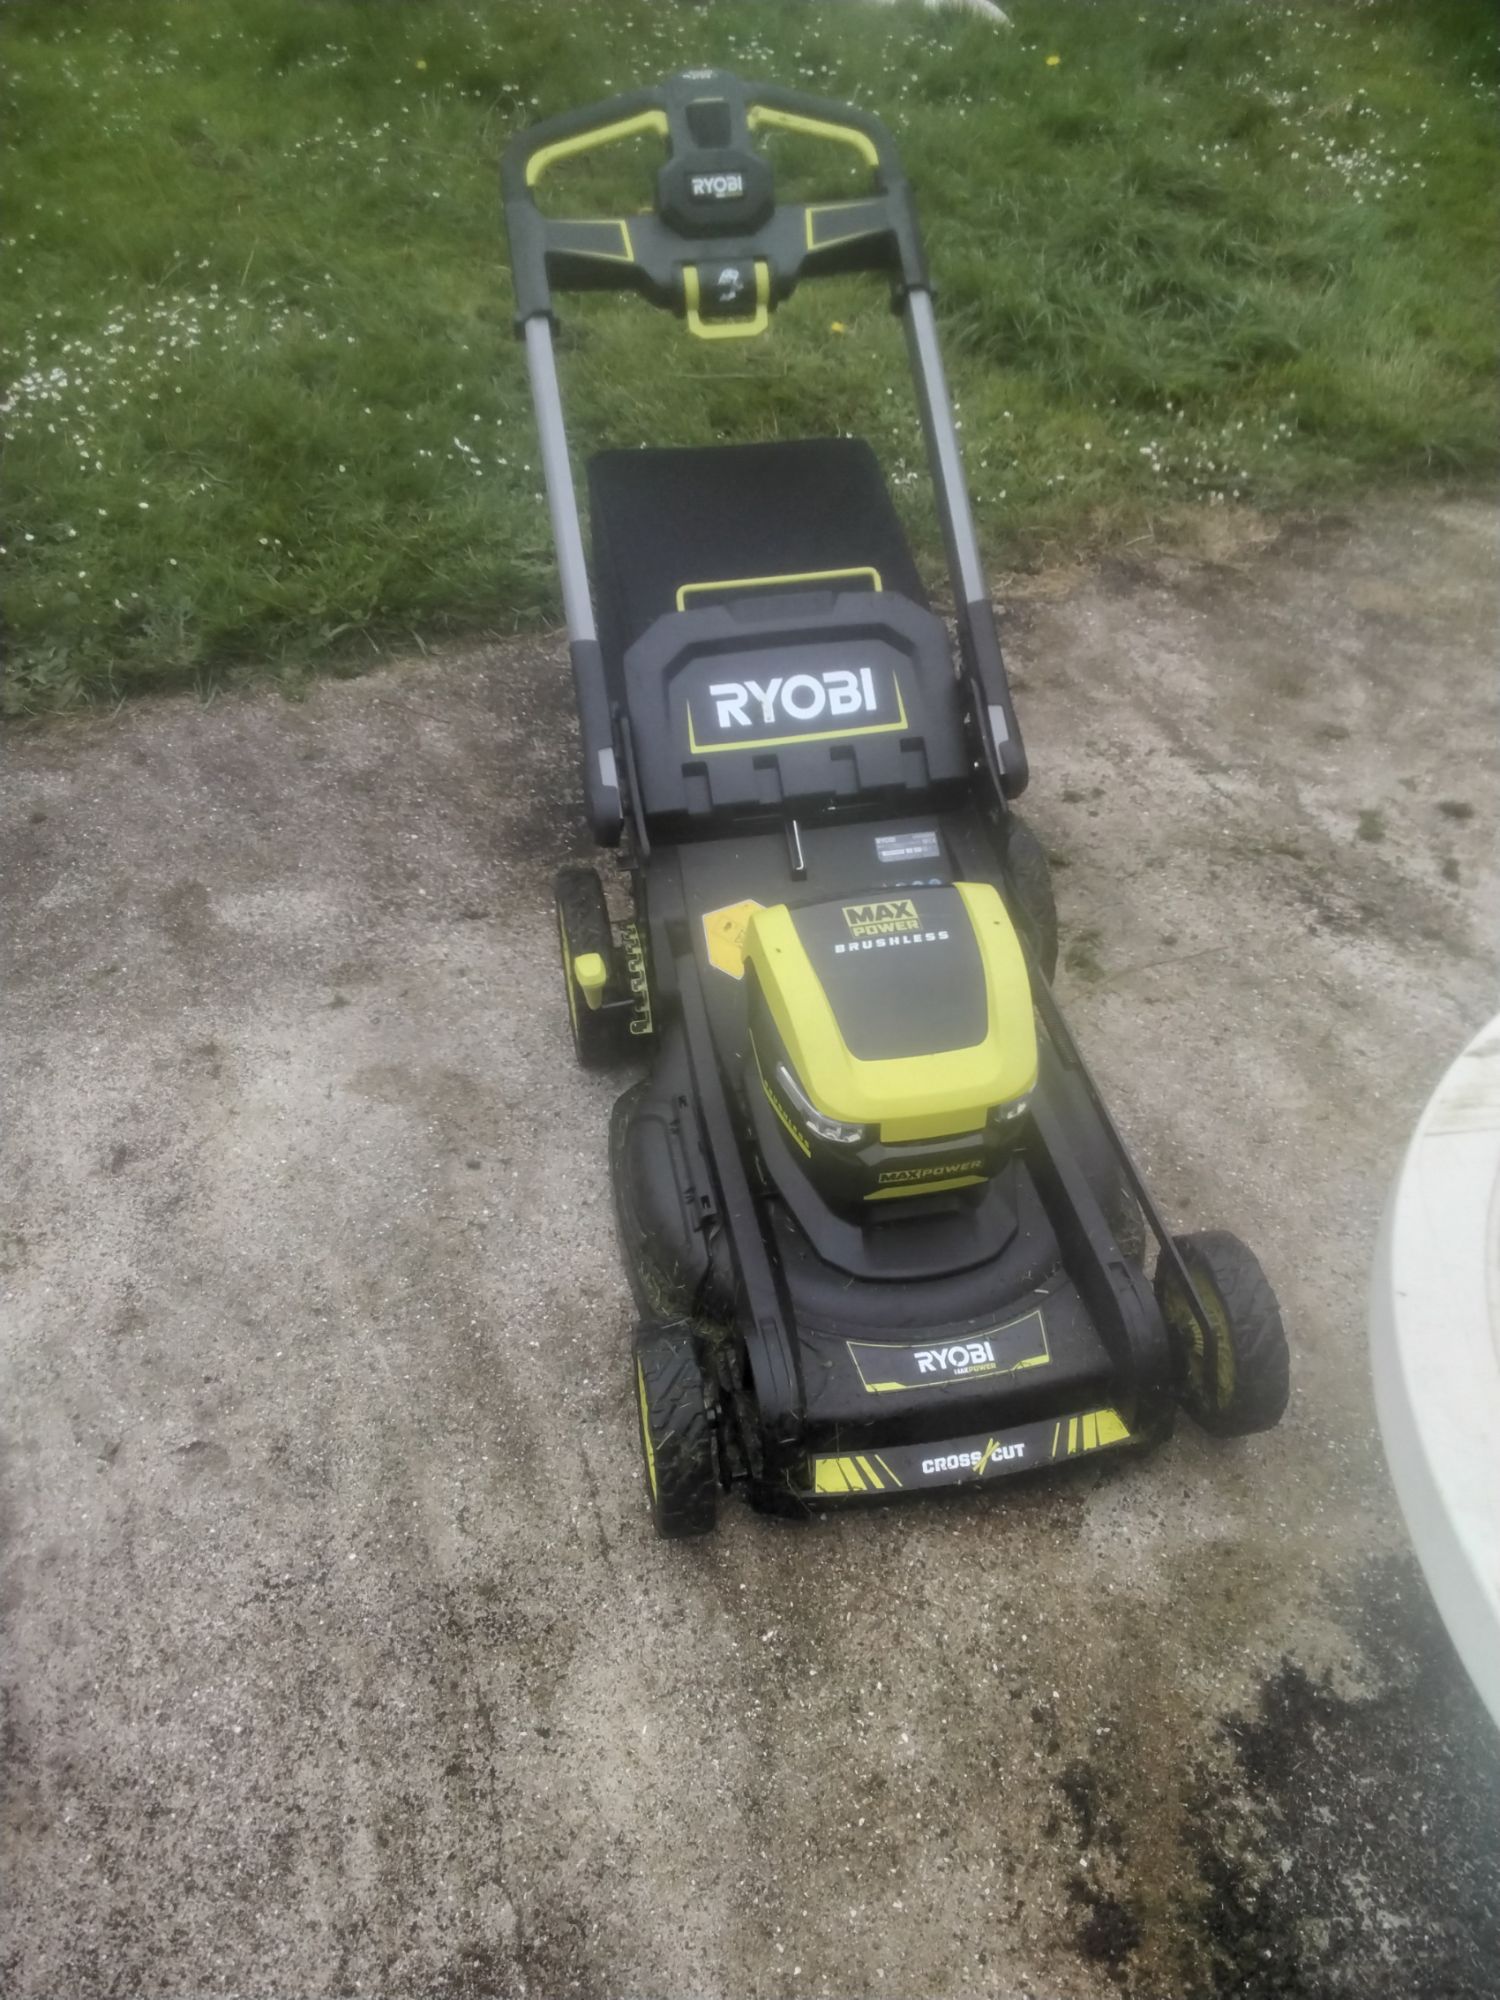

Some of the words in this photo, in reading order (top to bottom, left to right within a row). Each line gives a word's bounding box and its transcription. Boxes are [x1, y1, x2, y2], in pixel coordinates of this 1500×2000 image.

[691, 175, 743, 195] RYOBI
[709, 667, 877, 728] RYOBI
[846, 901, 914, 925] MAX
[853, 919, 919, 937] POWER
[834, 930, 949, 954] BRUSHLESS
[913, 1341, 995, 1373] RYOBI
[921, 1451, 982, 1474] CROSS
[991, 1443, 1025, 1462] CUT
